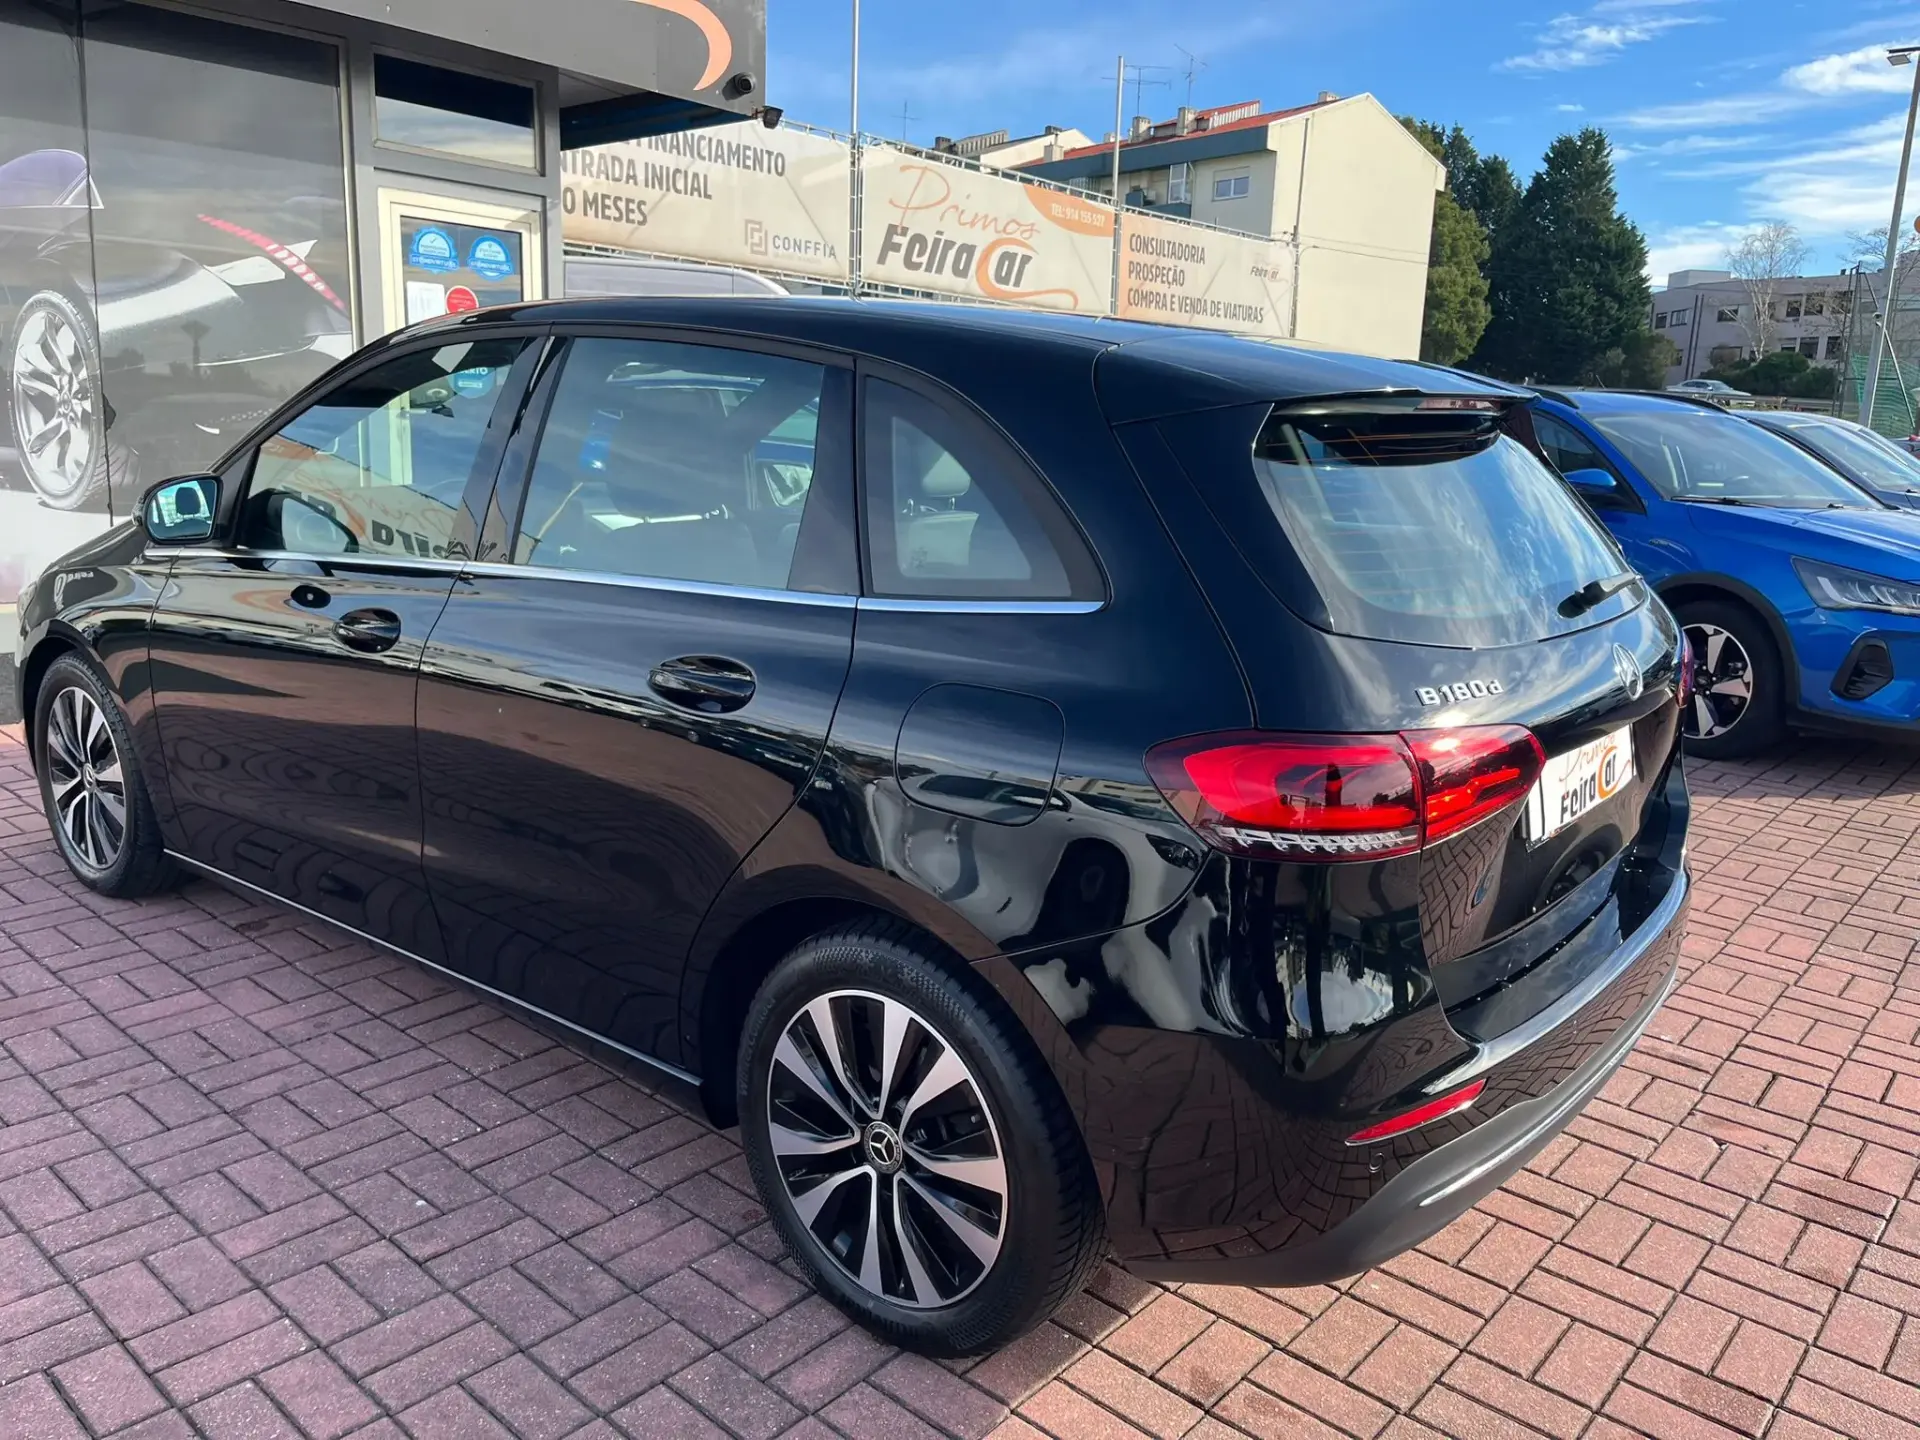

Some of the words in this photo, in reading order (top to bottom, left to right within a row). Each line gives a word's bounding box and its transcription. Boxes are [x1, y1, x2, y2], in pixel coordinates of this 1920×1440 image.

[560, 149, 638, 187] NTRADA
[644, 161, 713, 200] INICIAL
[583, 189, 648, 226] MESES
[889, 164, 1041, 240] Primos
[772, 234, 837, 259] CONFFIA
[1129, 233, 1206, 265] CONSULTADORIA
[1128, 260, 1185, 289] PROSPEÇÃO
[1127, 288, 1168, 312] COMPRA
[1170, 294, 1176, 312] E
[1178, 296, 1208, 317] VENDA
[1209, 300, 1221, 318] DE
[1223, 303, 1264, 324] VIATURAS
